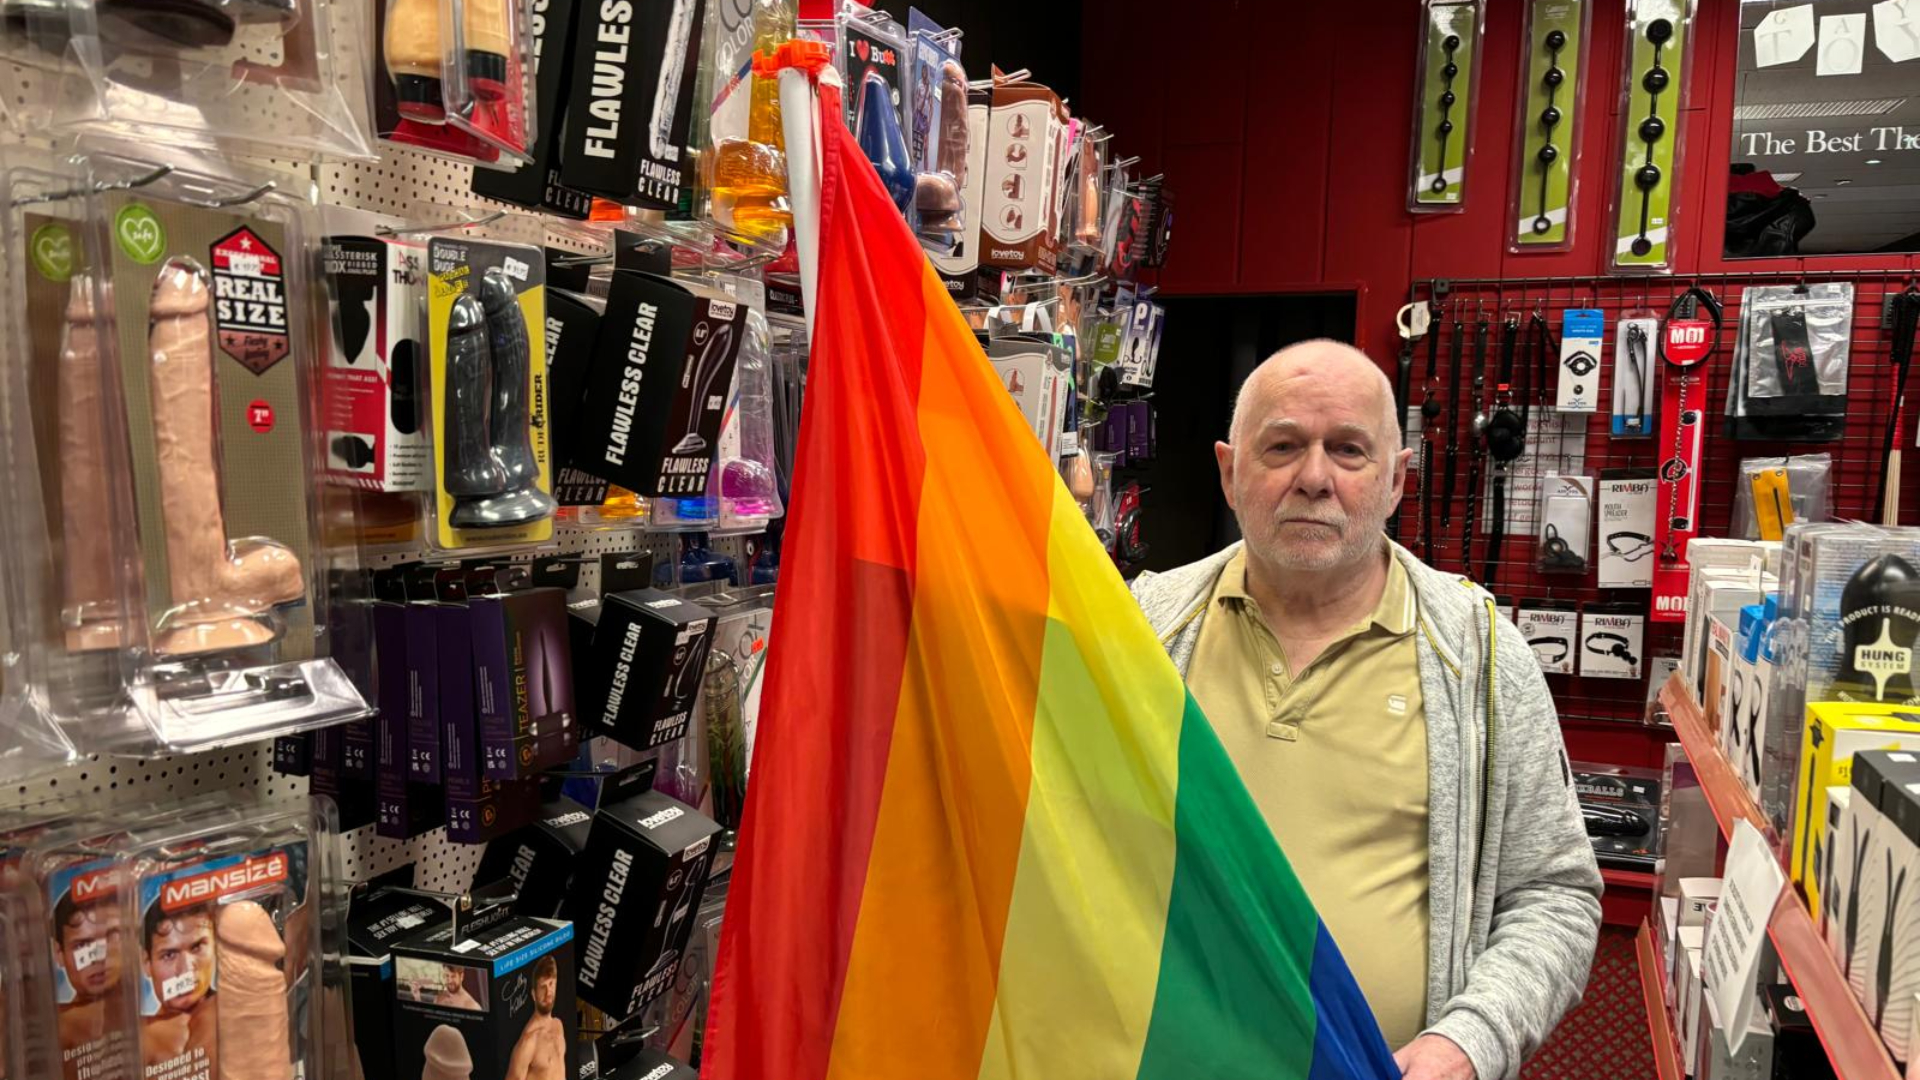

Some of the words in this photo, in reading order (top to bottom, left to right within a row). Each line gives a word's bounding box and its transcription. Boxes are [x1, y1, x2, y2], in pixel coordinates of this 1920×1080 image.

[715, 16, 755, 73] COLOR
[1740, 132, 1795, 156] The
[1805, 129, 1863, 154] Best
[640, 159, 681, 186] FLAWLESS
[545, 187, 589, 215] CLEAR
[638, 177, 679, 205] CLEAR
[433, 245, 466, 262] DOUBLE
[991, 248, 1024, 260] lovetoy
[215, 276, 284, 303] REAL
[217, 300, 286, 326] SIZE
[546, 317, 565, 373] LEAR
[605, 366, 643, 466] FLAWLESS
[627, 302, 658, 365] CLEAR
[557, 468, 607, 484] FLAWL
[661, 457, 709, 474] FLAWLESS
[657, 474, 705, 493] CLEAR
[1837, 605, 1879, 627] PRODUCT
[1881, 605, 1891, 614] IS
[1861, 650, 1905, 662] HUNG
[1861, 661, 1905, 670] SYSTEM
[602, 661, 631, 727] FLAWLESS
[620, 622, 642, 662] CLEAR
[515, 674, 530, 732] TEAZER
[649, 723, 685, 746] CLEAR
[653, 711, 688, 733] FLAWLESS
[510, 844, 536, 897] LEAR
[578, 902, 616, 988] FLAWLESS
[605, 848, 634, 908] CLEAR
[631, 959, 679, 999] FLAWLESS
[145, 1051, 192, 1077] Designed
[194, 1047, 205, 1057] to
[193, 1058, 210, 1071] you
